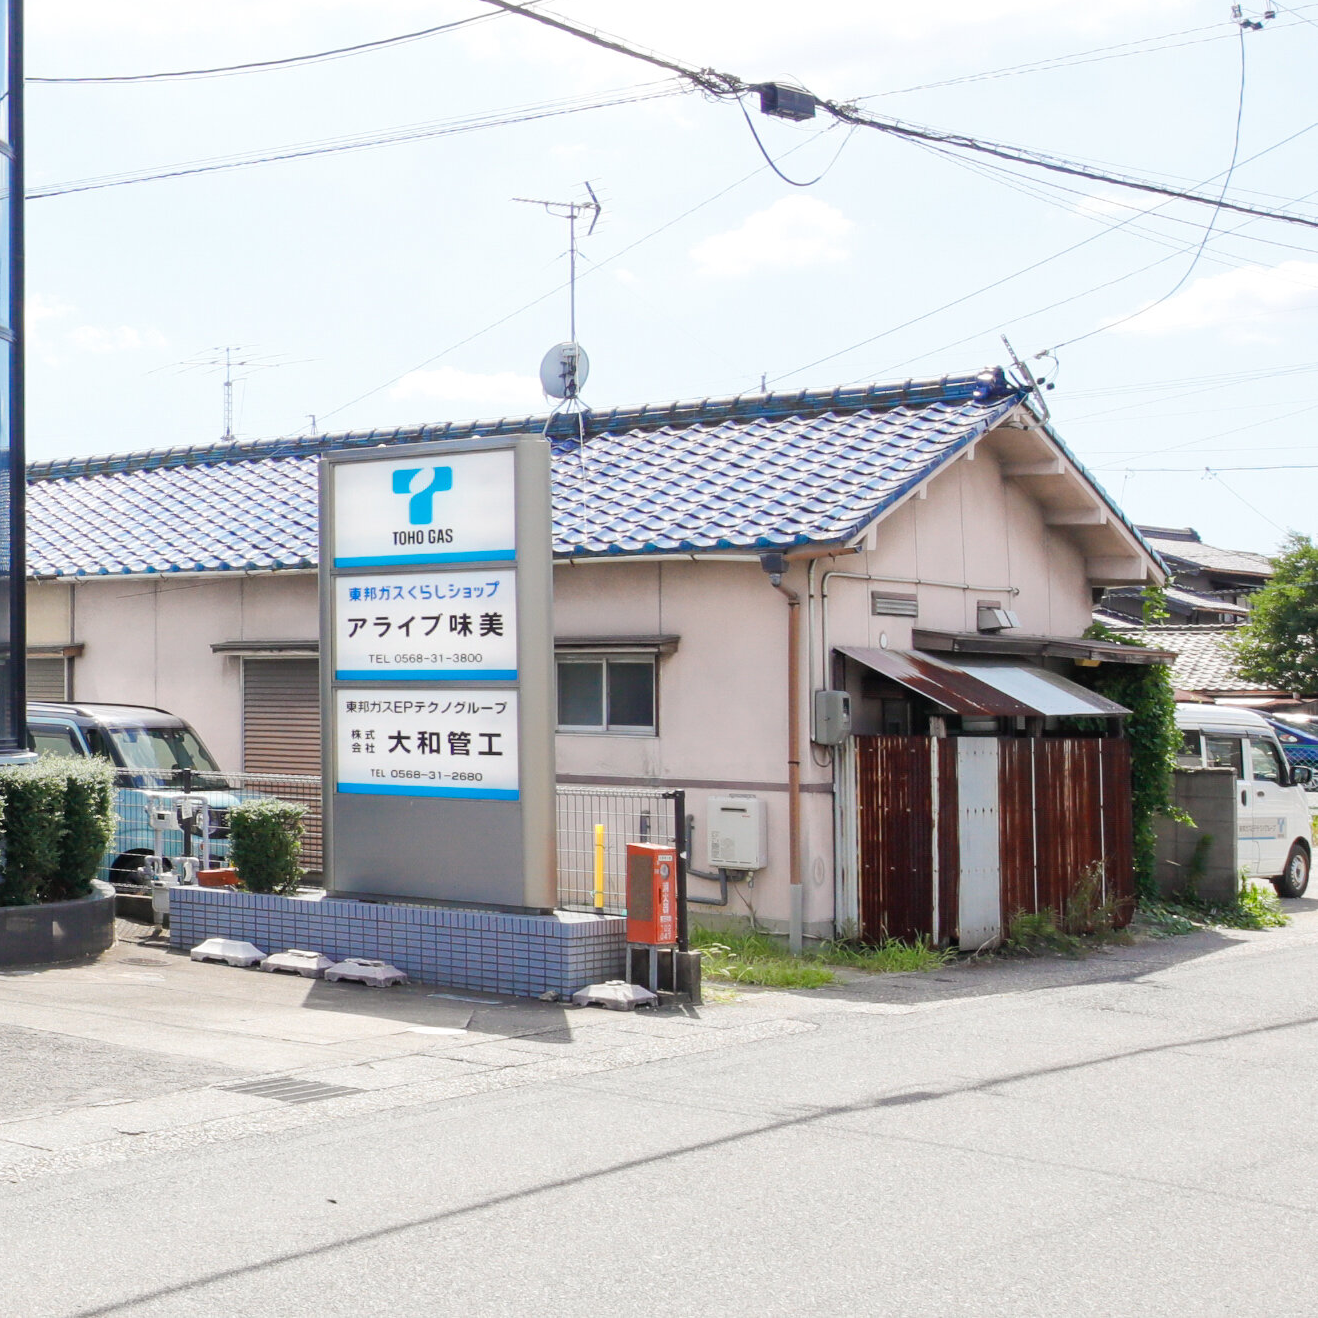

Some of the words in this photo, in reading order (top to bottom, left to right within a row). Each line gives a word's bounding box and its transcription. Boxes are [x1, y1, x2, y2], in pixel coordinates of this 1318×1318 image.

[393, 530, 424, 546] TOHO
[428, 528, 454, 545] GAS
[349, 581, 500, 601] 東邦ガスくらしショップ
[347, 612, 504, 639] アライブ味美
[369, 654, 390, 664] TEL
[394, 654, 483, 664] 0568-31-3800
[346, 700, 507, 716] 東邦ガスEPテクノグループ
[351, 729, 375, 740] 株式
[352, 742, 375, 754] 会社
[388, 730, 504, 757] 大和管工
[370, 768, 386, 778] TEL
[390, 769, 483, 782] 0568-31-2680
